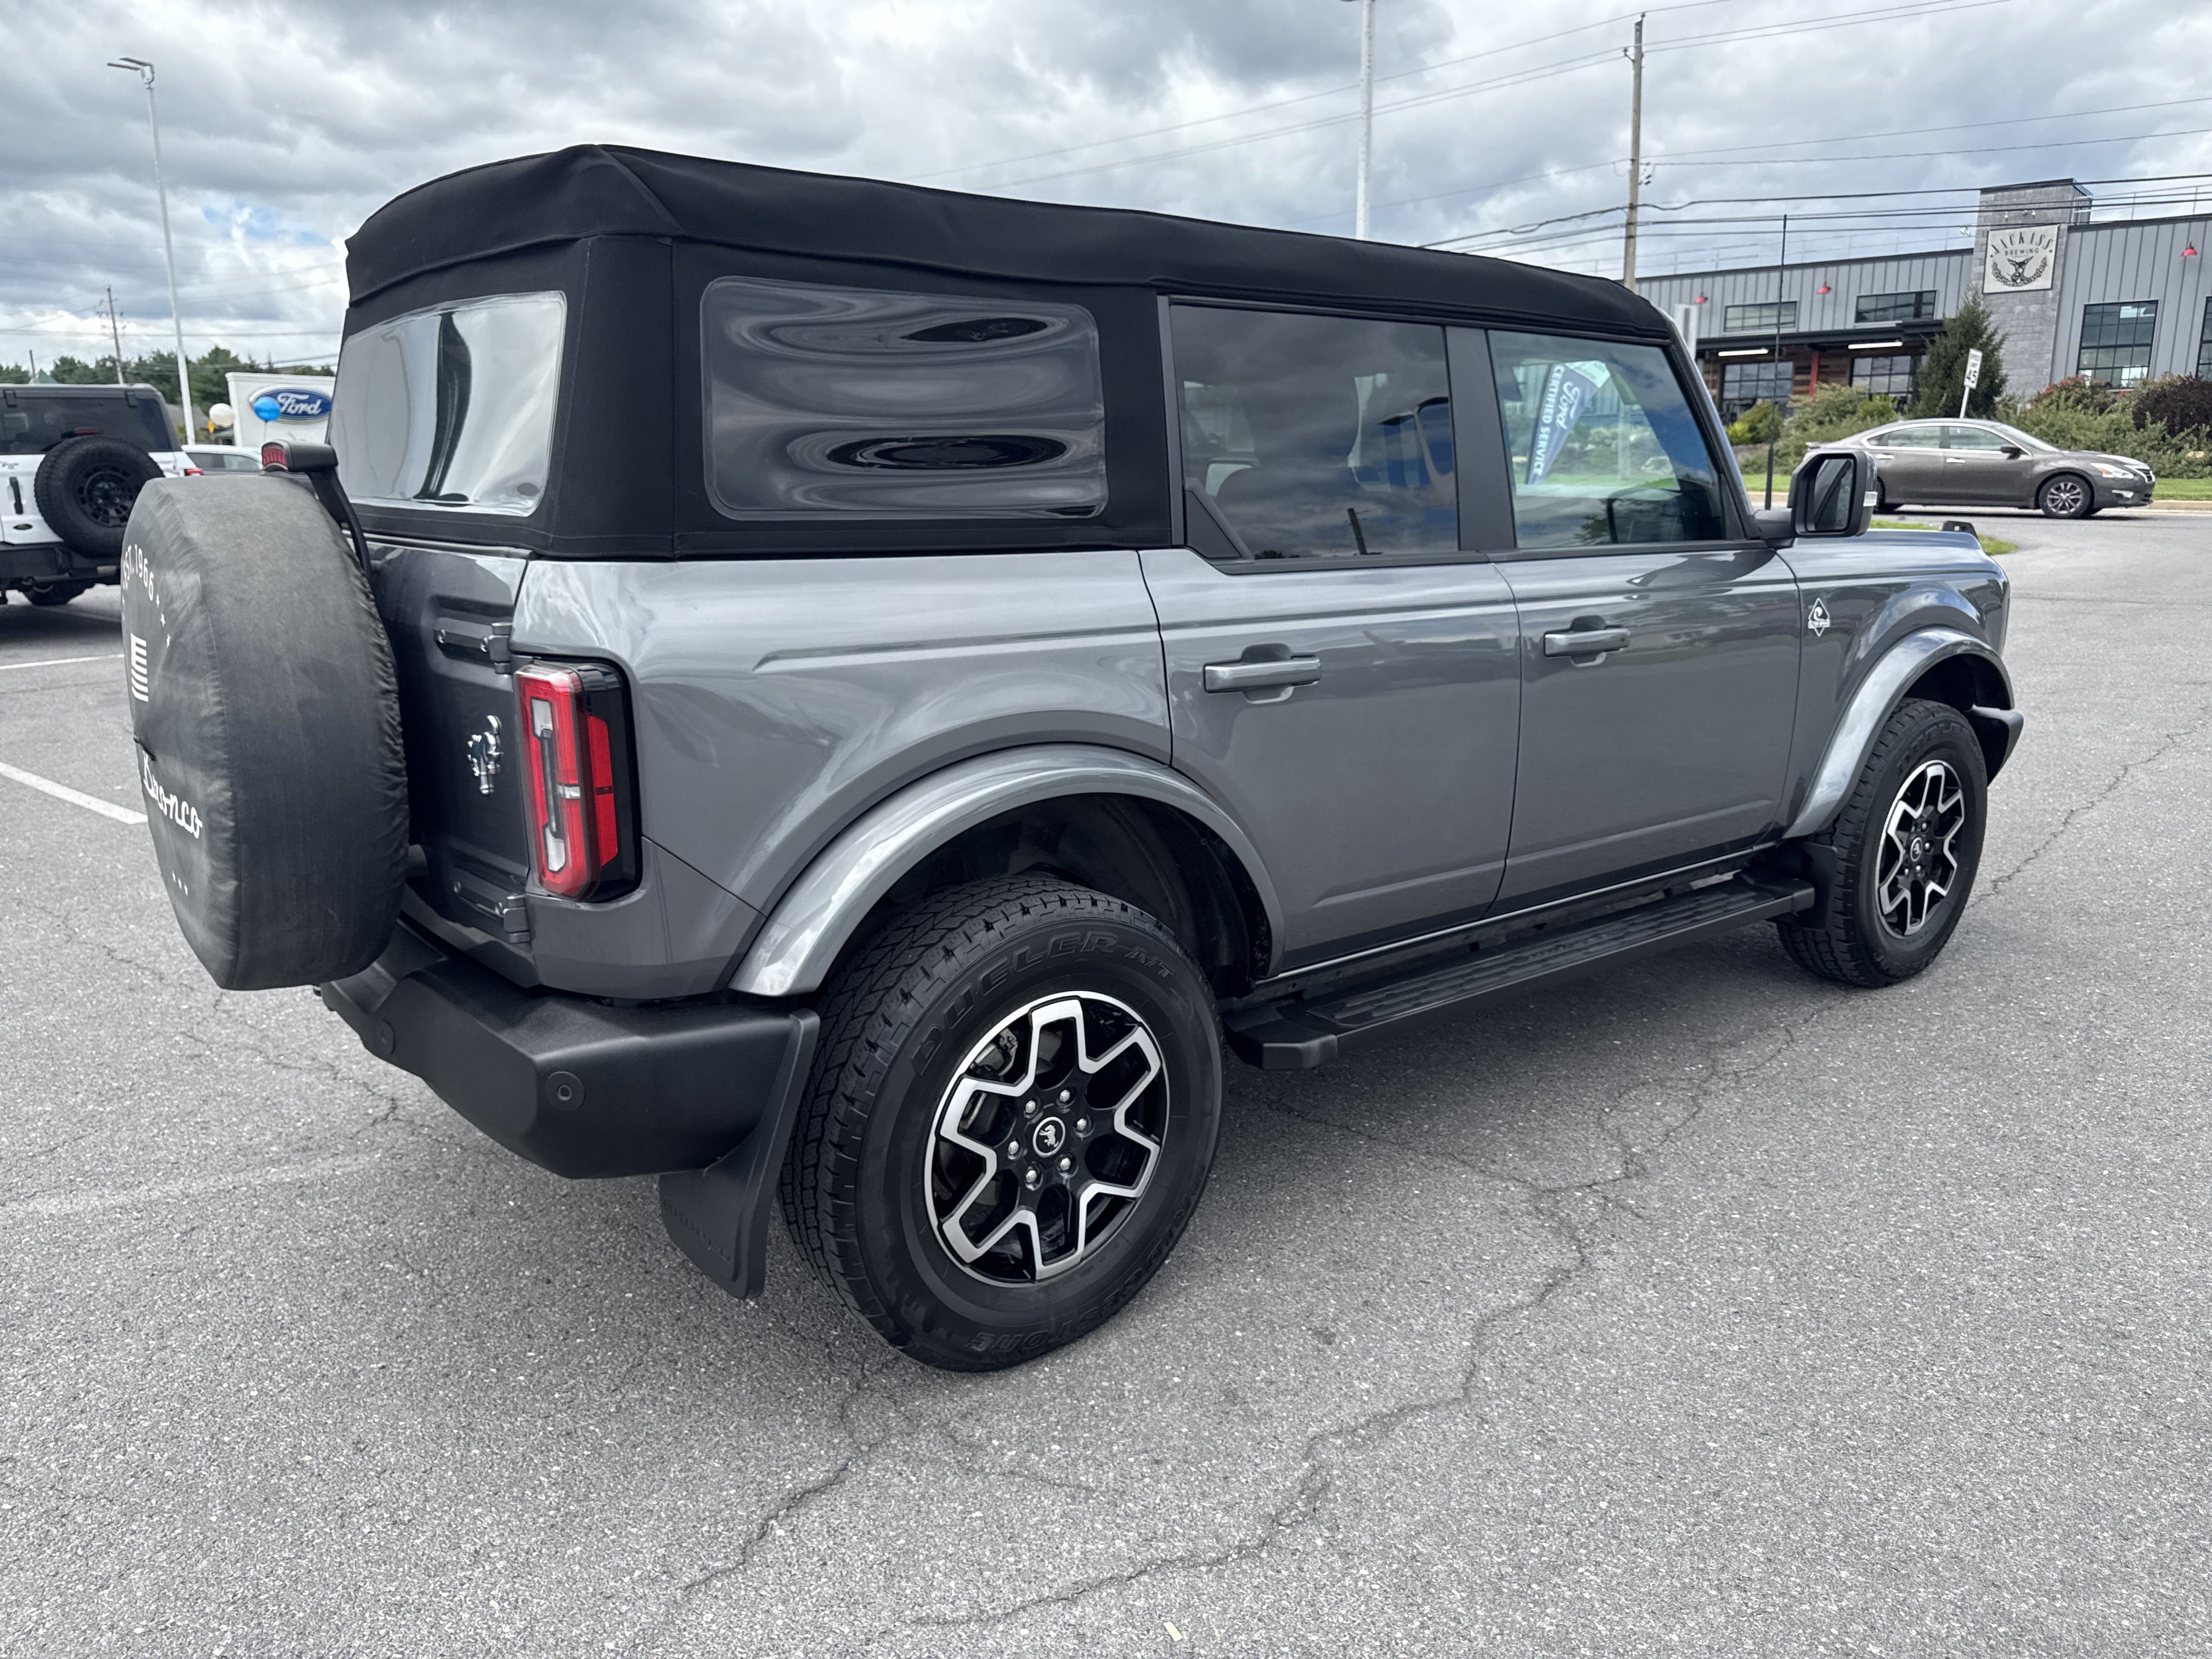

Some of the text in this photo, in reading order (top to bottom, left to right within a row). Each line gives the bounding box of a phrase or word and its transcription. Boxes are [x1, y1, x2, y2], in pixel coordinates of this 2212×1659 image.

[2004, 247, 2039, 256] BREWING
[1966, 369, 1977, 383] 45
[277, 392, 323, 415] Ford
[1534, 365, 1565, 476] CERTIFIED SERVICE
[1555, 381, 1581, 430] Ford
[135, 544, 154, 601] 1966
[909, 930, 1175, 1076] DUELER A/T
